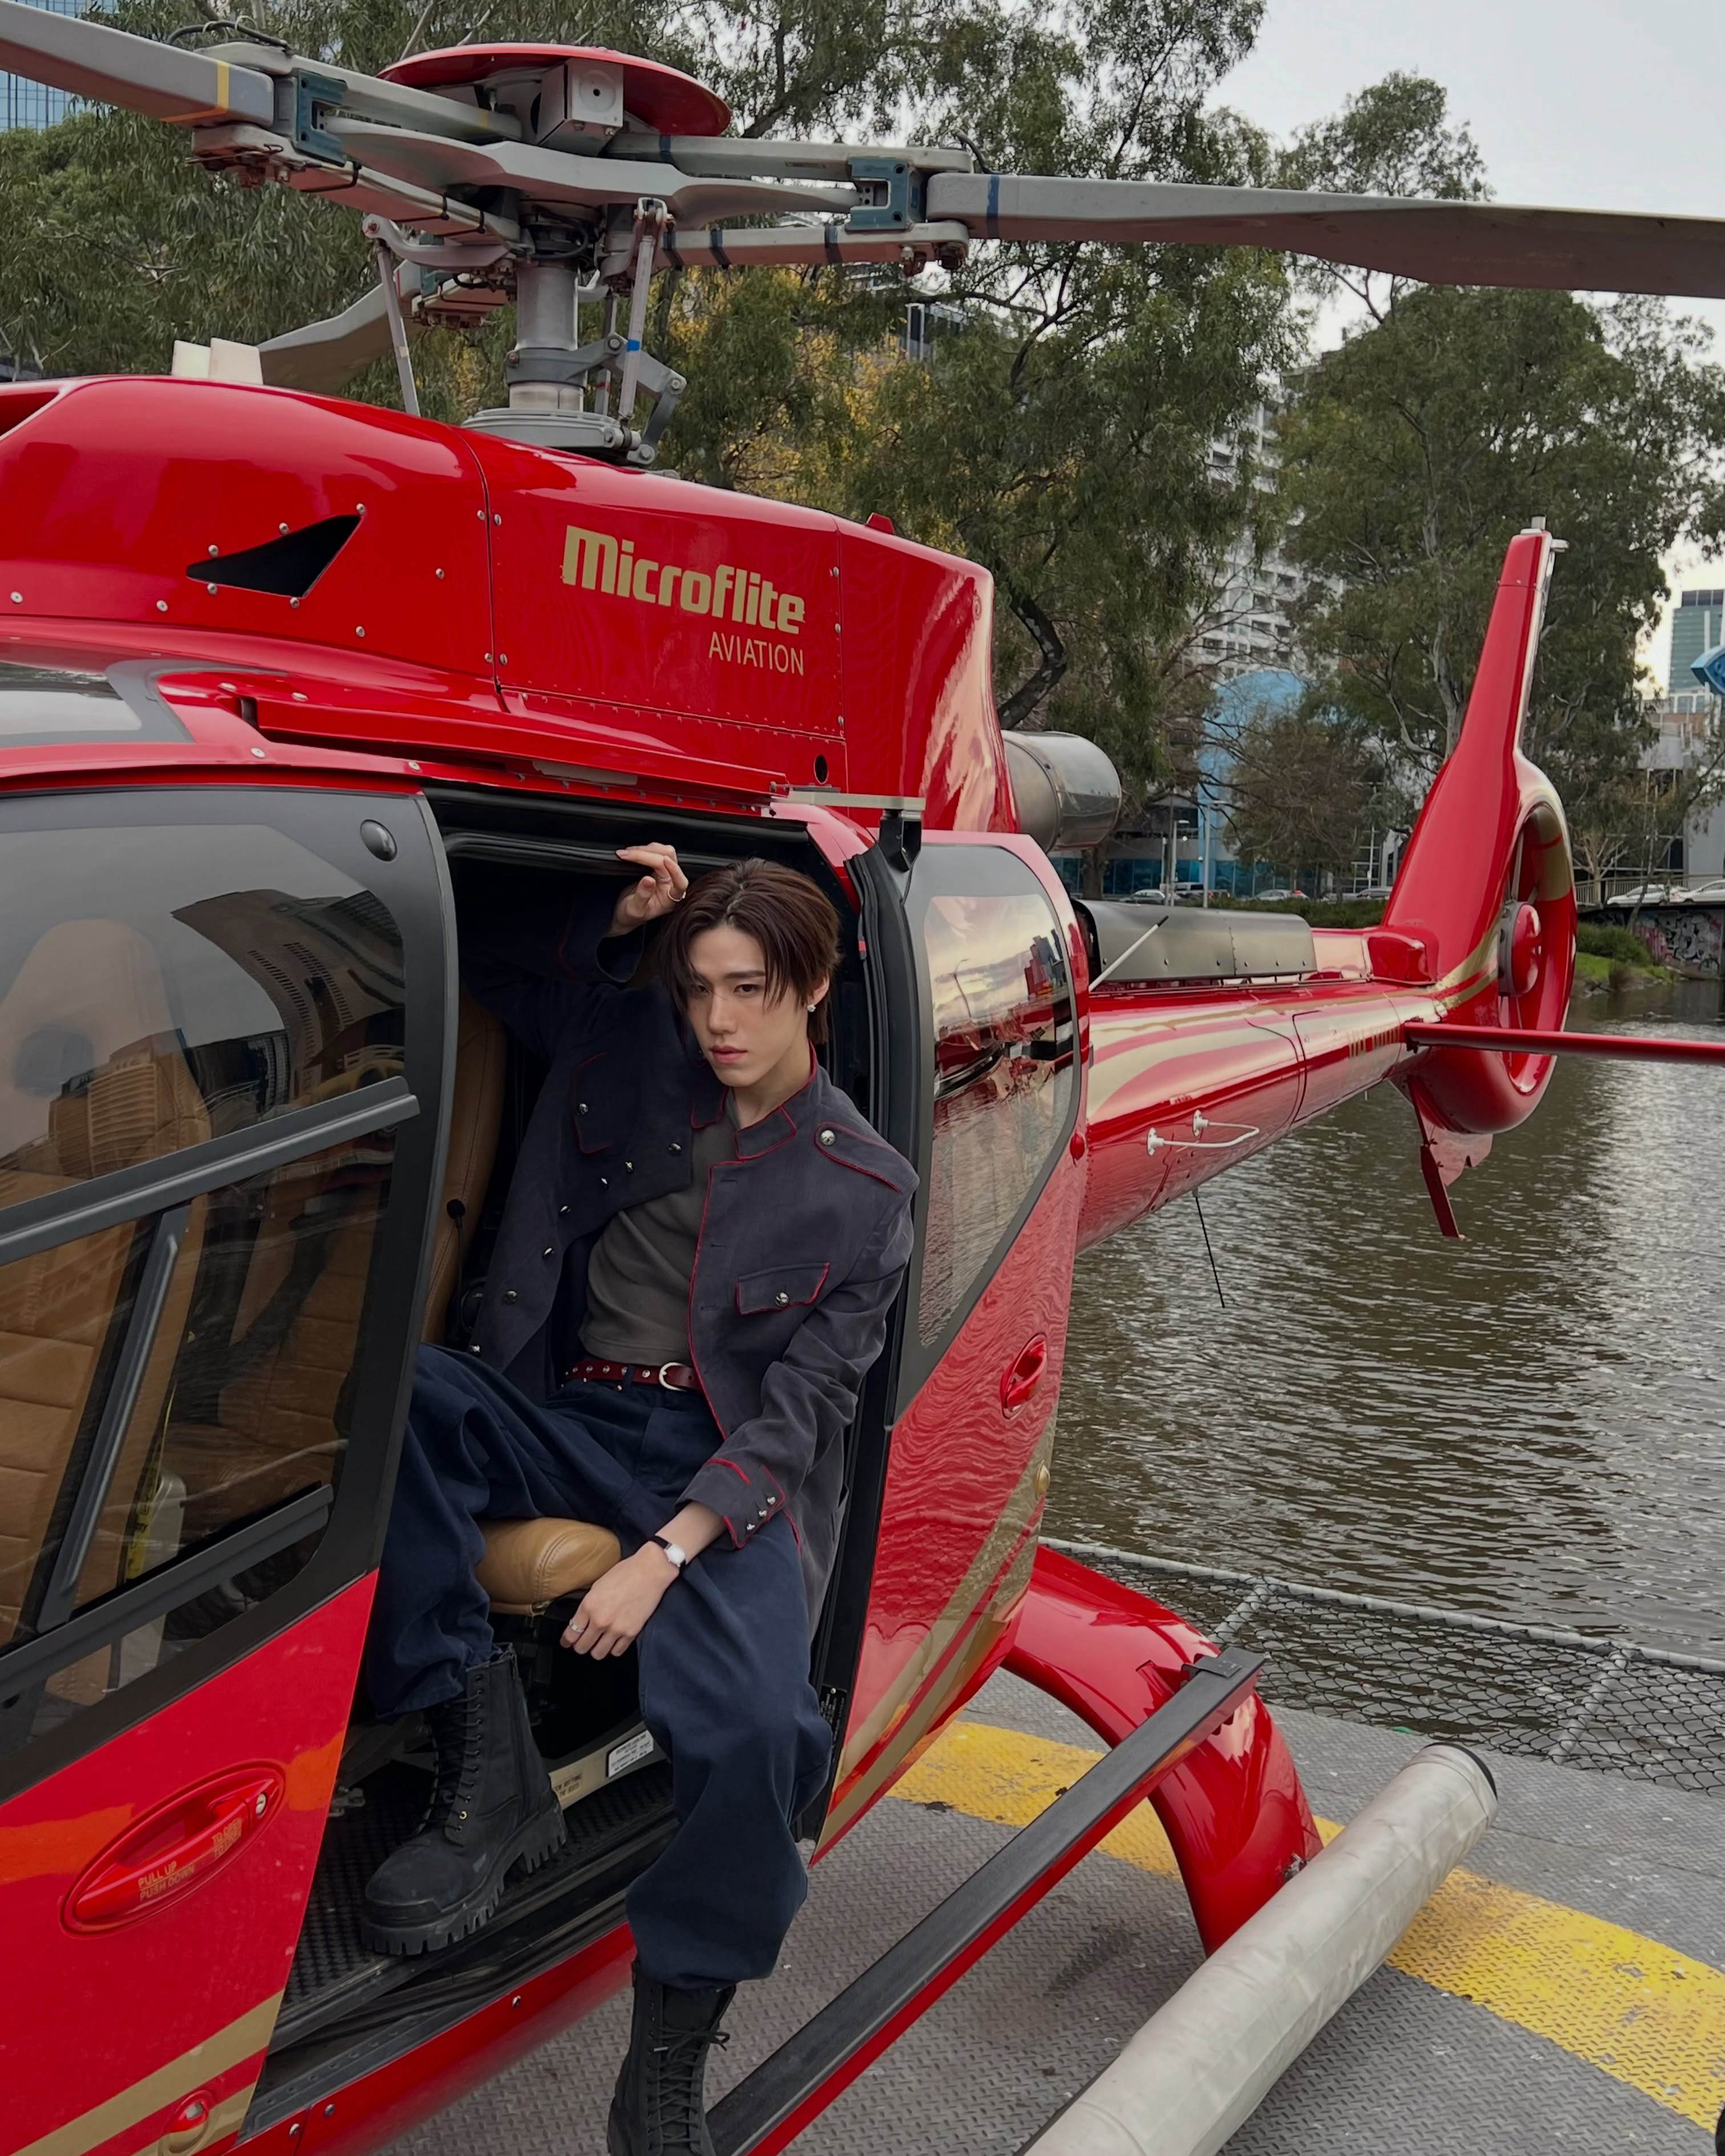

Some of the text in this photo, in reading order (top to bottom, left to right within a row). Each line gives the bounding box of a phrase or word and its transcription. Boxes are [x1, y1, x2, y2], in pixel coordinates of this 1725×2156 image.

[562, 525, 805, 634] Microflite
[708, 631, 804, 676] AVIATION
[138, 1869, 164, 1889] PULL
[164, 1860, 177, 1876] UP
[140, 1880, 167, 1902] PUSH
[168, 1864, 195, 1887] DOWN
